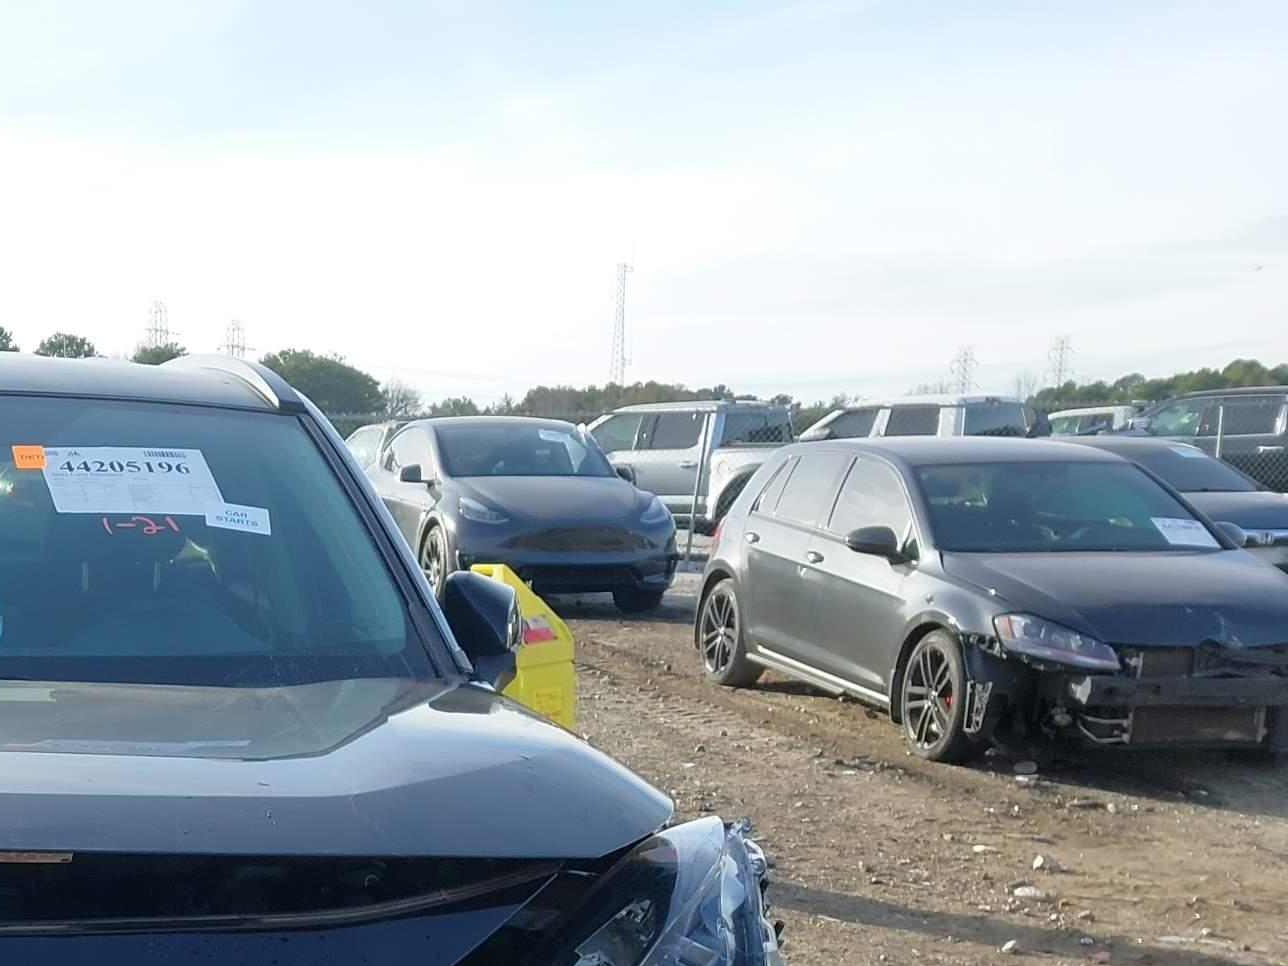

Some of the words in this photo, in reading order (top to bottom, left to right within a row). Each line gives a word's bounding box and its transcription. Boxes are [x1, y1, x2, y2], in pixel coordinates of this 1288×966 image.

[59, 460, 190, 474] 44205196
[225, 510, 248, 518] CAR
[102, 516, 180, 534] 1-21
[215, 515, 259, 527] STARTS
